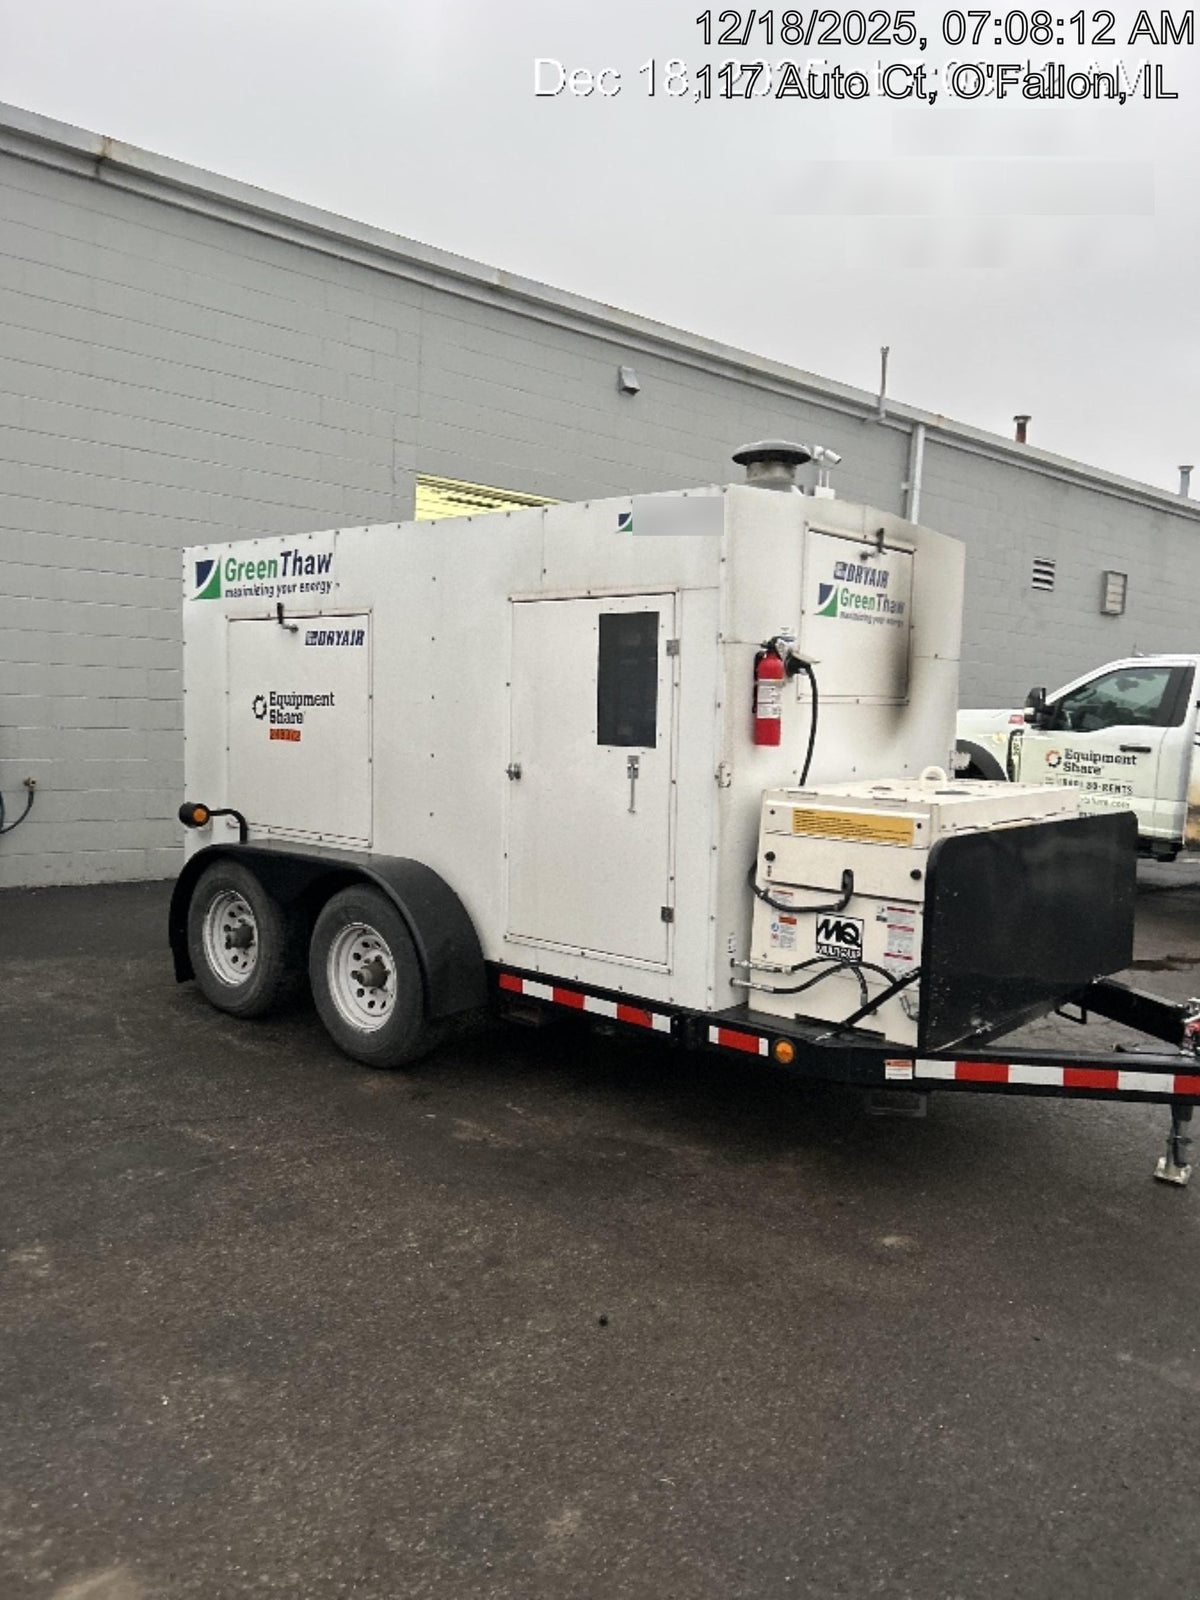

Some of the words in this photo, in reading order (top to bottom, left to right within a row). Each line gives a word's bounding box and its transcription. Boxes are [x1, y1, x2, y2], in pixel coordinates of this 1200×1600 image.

[269, 691, 335, 709] Equipment
[269, 708, 304, 725] Share
[1064, 748, 1138, 766] Equipment
[1062, 761, 1103, 775] Share
